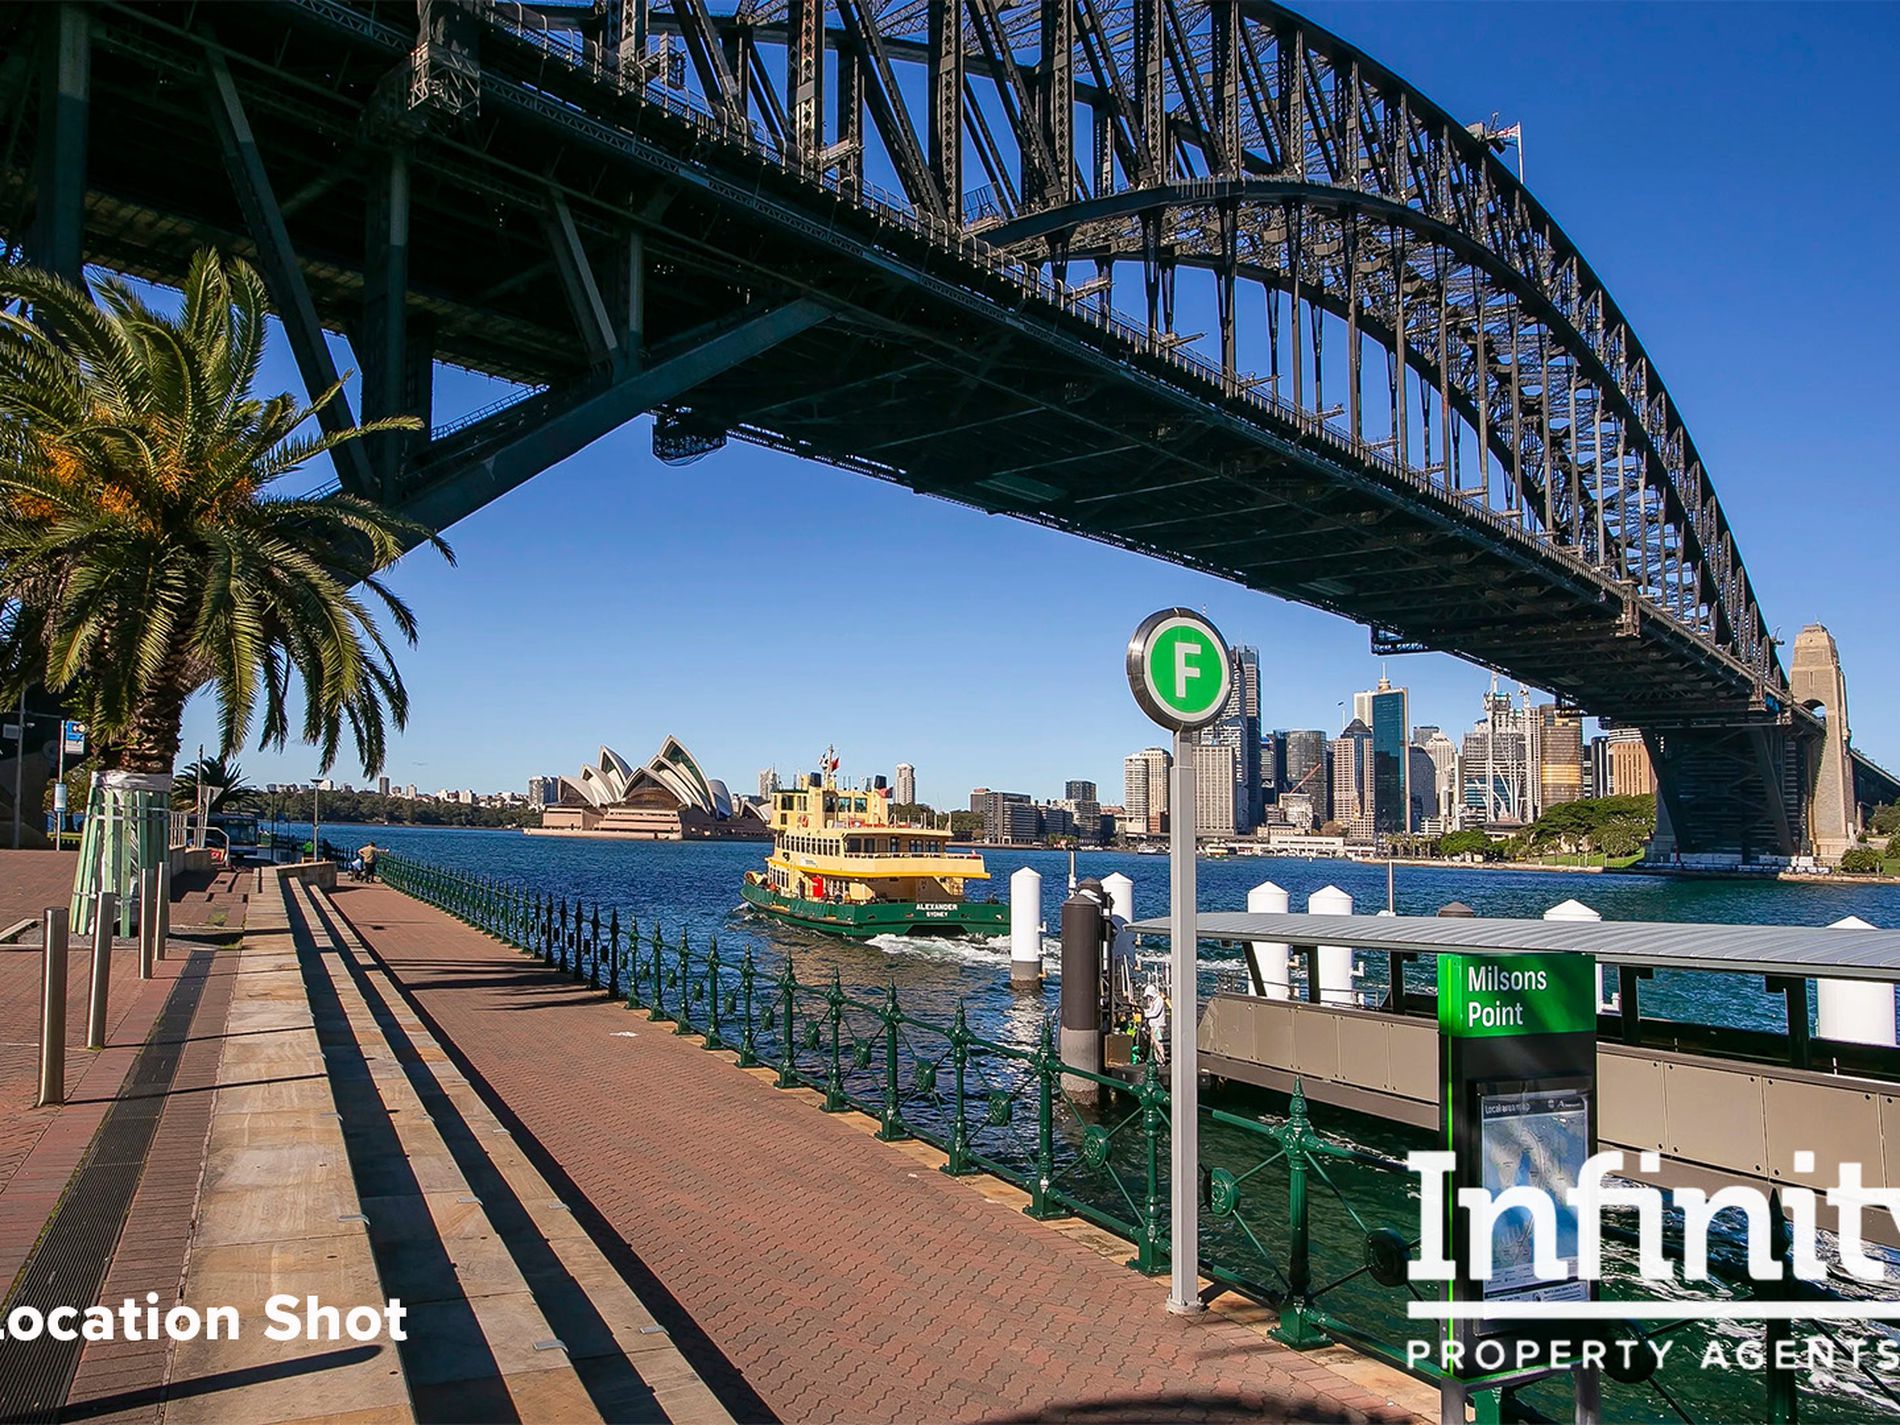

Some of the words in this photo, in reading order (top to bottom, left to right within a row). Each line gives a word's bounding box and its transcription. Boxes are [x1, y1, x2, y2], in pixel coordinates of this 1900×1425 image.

[1174, 642, 1201, 698] F
[1468, 966, 1547, 991] Milsons
[1468, 1001, 1524, 1028] Point
